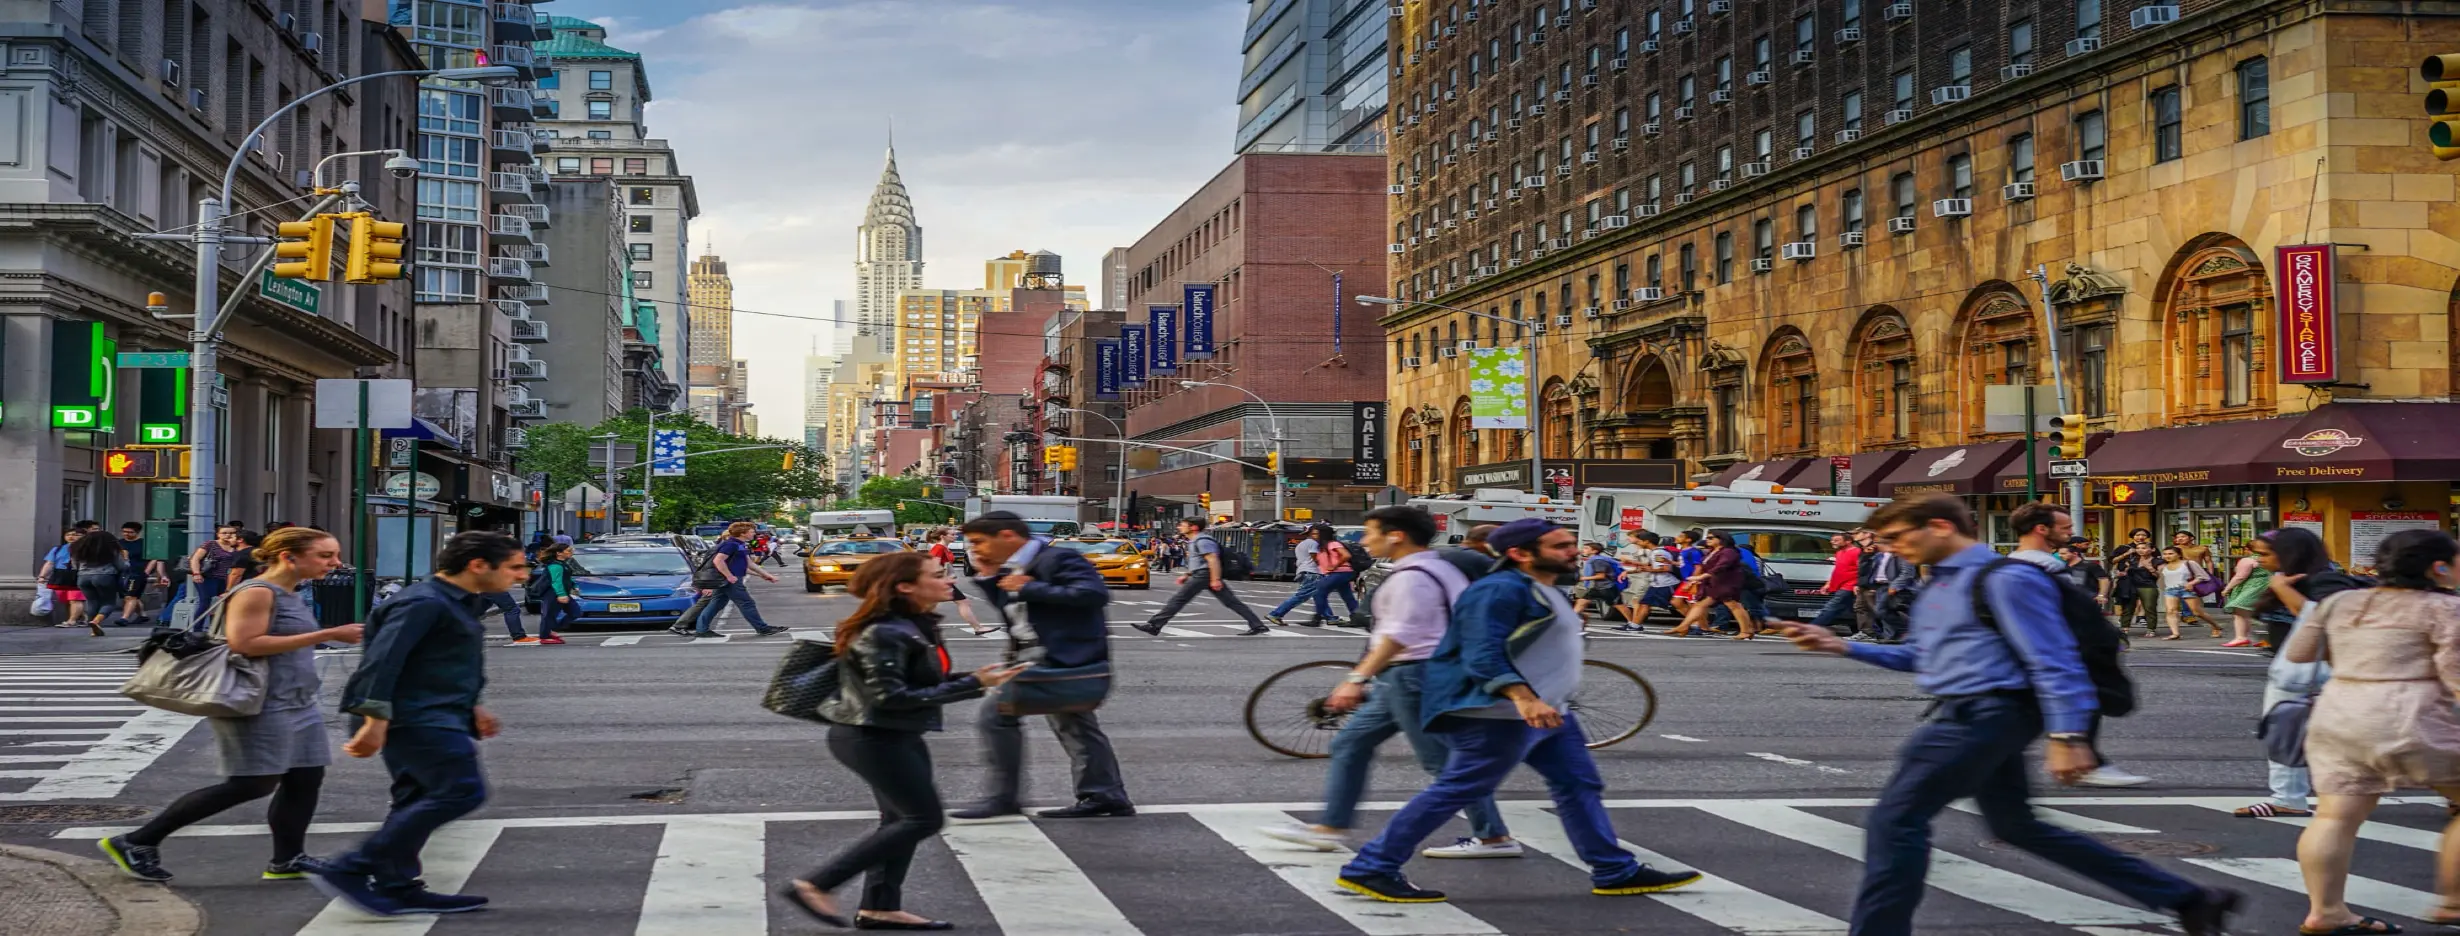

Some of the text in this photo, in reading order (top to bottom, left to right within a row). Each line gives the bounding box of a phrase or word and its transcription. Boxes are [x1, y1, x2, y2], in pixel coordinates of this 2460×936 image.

[268, 276, 315, 307] Lexington Av
[140, 354, 168, 366] 23
[56, 409, 92, 424] TD
[145, 427, 176, 439] TD
[1362, 407, 1376, 459] CAFE
[1485, 469, 1520, 483] WASHINGTON
[2178, 470, 2210, 481] BAKERY
[2276, 465, 2365, 476] Free Delivery
[1777, 509, 1821, 517] verizon
